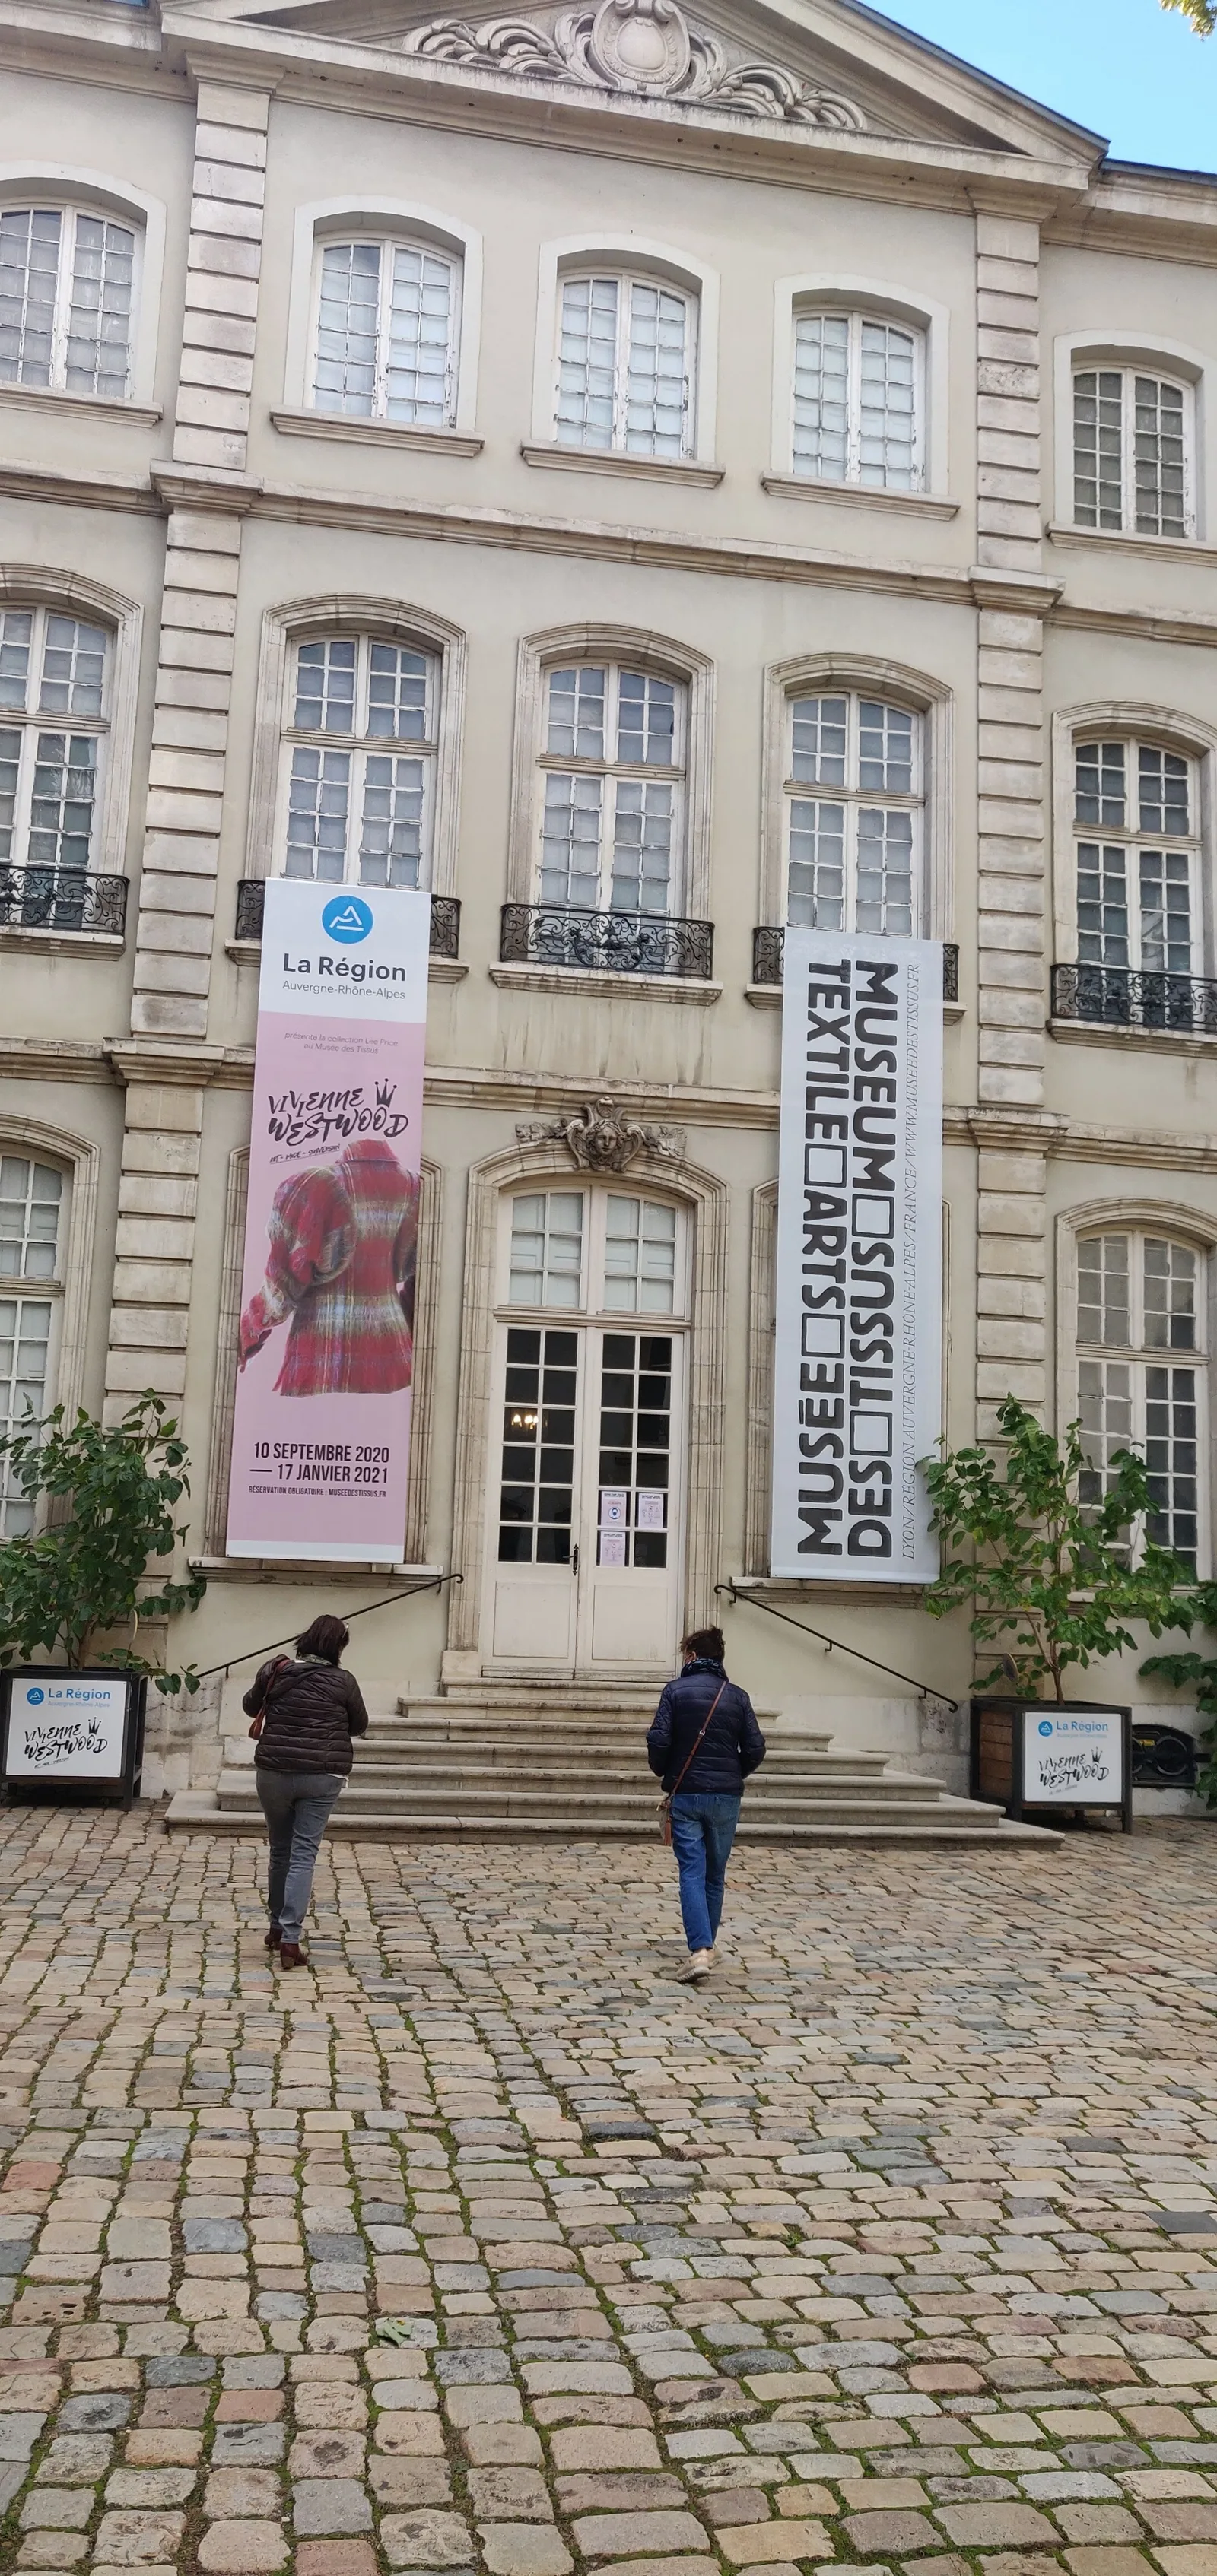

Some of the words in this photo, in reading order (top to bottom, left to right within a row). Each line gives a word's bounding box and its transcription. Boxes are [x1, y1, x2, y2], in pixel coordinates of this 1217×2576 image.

[283, 953, 311, 973] La
[319, 956, 406, 982] Région
[282, 979, 405, 1000] Auvergne-Rhône-Alpes
[284, 1032, 318, 1041] présente
[327, 1035, 364, 1044] collection
[380, 1039, 399, 1047] Price
[357, 1045, 379, 1055] Tissus
[805, 958, 851, 1140] TEXTILE
[853, 960, 898, 1191] MUSEUM
[267, 1087, 365, 1118] VIVIENNE
[267, 1106, 409, 1147] WESTWOOD
[801, 1189, 848, 1310] ARTS
[849, 1242, 895, 1407] TISSUS
[254, 1442, 270, 1458] 10
[273, 1442, 352, 1461] SEPTEMBRE
[355, 1446, 389, 1463] 2020
[797, 1363, 844, 1556] MUSÉE
[278, 1464, 294, 1480] 17
[296, 1464, 351, 1482] JANVIER
[354, 1466, 388, 1483] 2021
[249, 1484, 287, 1495] RÉSERVATION
[288, 1487, 324, 1496] OBLIGATOIRE
[329, 1489, 386, 1498] MUSEEDESTISSUS.FR
[847, 1460, 893, 1558] DES
[48, 1687, 62, 1698] La
[65, 1688, 110, 1701] Région
[24, 1724, 83, 1743] VIVIENNE
[1056, 1721, 1069, 1731] La
[1071, 1721, 1108, 1733] Région
[24, 1734, 108, 1762] WESTWOOD
